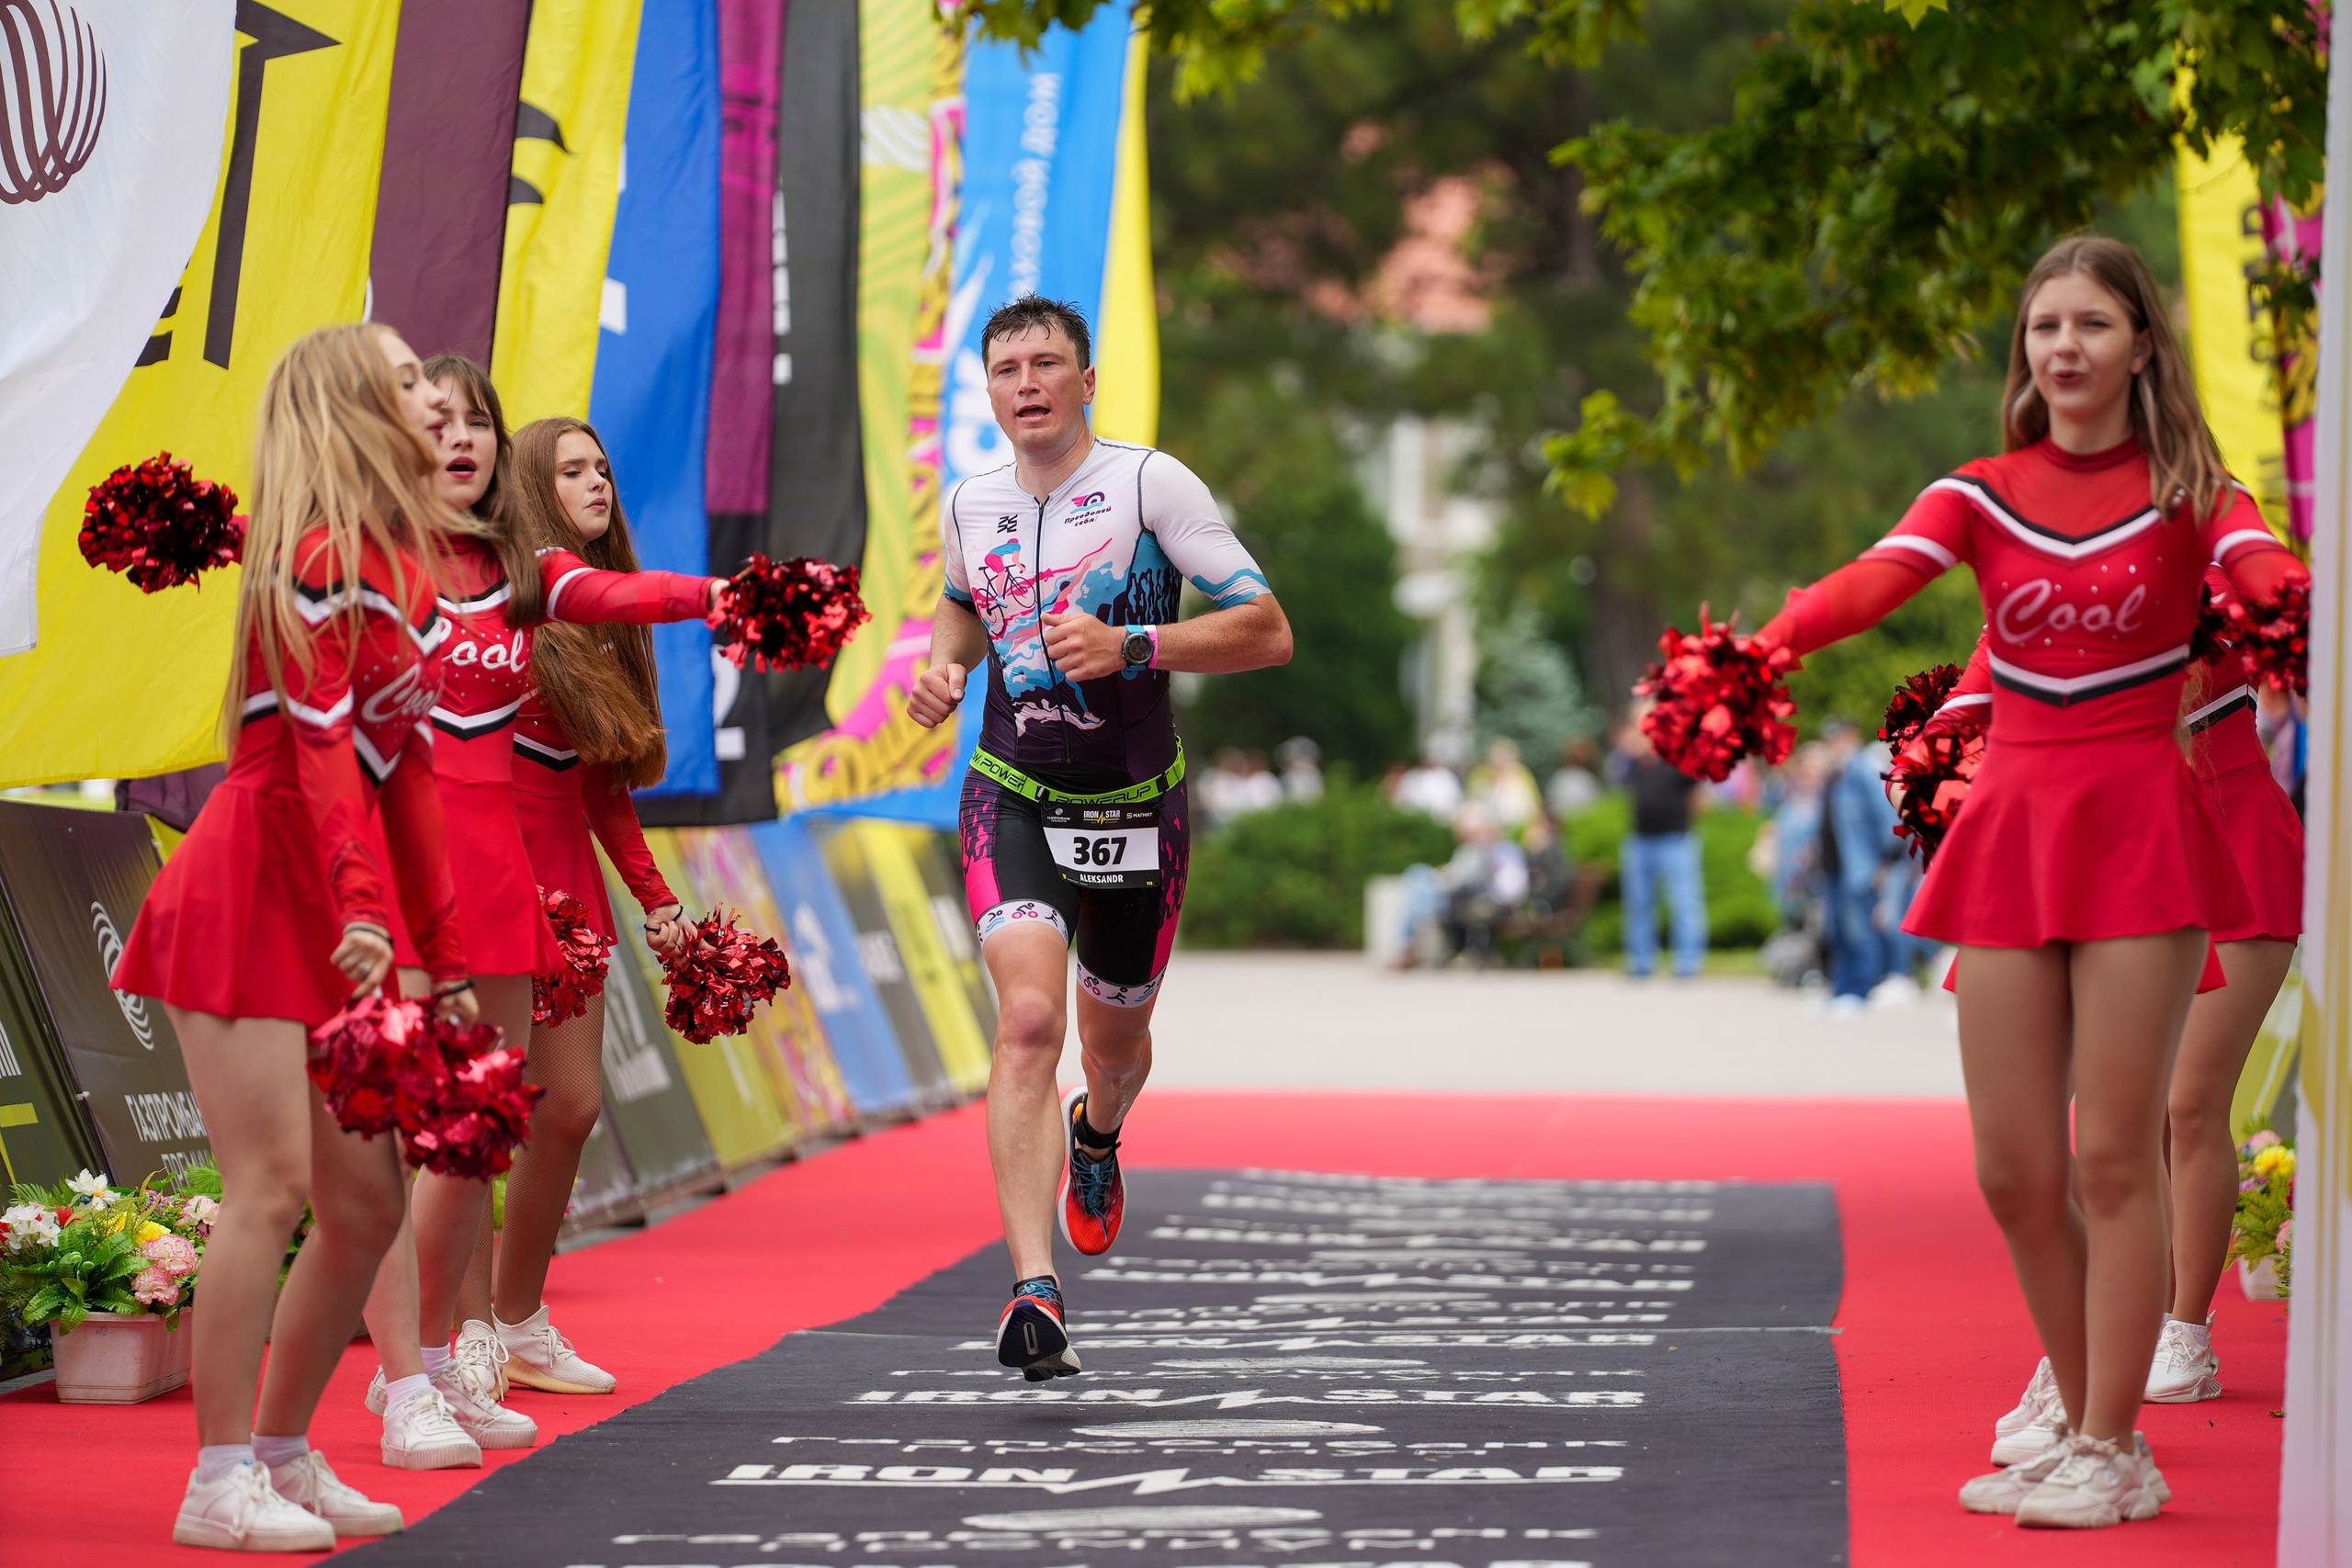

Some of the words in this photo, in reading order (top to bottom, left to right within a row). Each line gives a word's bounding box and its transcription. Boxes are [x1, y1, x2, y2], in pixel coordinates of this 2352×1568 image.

[1064, 505, 1112, 525] Преодолей
[1996, 579, 2147, 643] Cool
[1083, 810, 1099, 818] IRON
[1105, 809, 1121, 818] STAR
[1073, 836, 1127, 866] 367
[1080, 874, 1124, 884] ALEKSANDR
[856, 1388, 1165, 1402] IRON
[1322, 1389, 1645, 1404] STAR
[724, 1463, 1078, 1483] IRON
[1257, 1466, 1625, 1481] STAR
